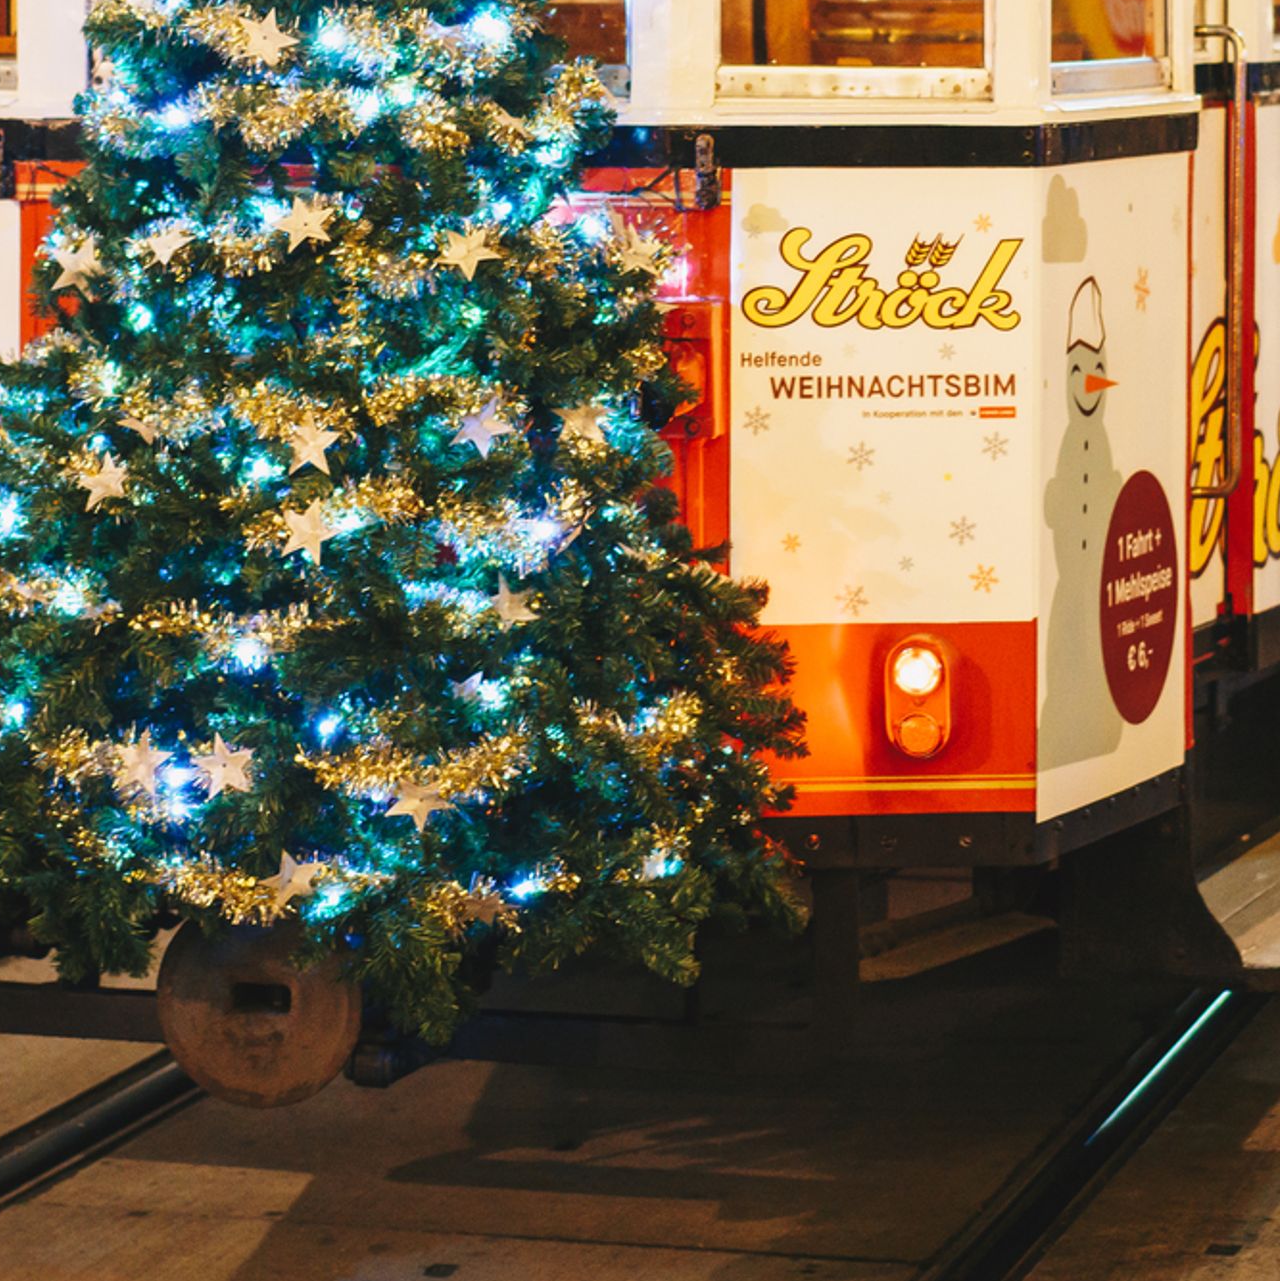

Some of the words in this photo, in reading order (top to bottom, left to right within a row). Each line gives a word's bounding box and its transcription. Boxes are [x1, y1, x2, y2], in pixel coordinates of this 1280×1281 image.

[741, 227, 1024, 331] Ströck
[740, 351, 823, 368] Helfende
[769, 373, 1016, 400] WEIHNACHTSBIM
[1118, 536, 1124, 562] 1
[1126, 528, 1154, 560] Fahrt
[1155, 528, 1162, 546] +
[1107, 581, 1113, 607] 1
[1114, 564, 1173, 605] Mehlspeise
[1127, 644, 1136, 672] €
